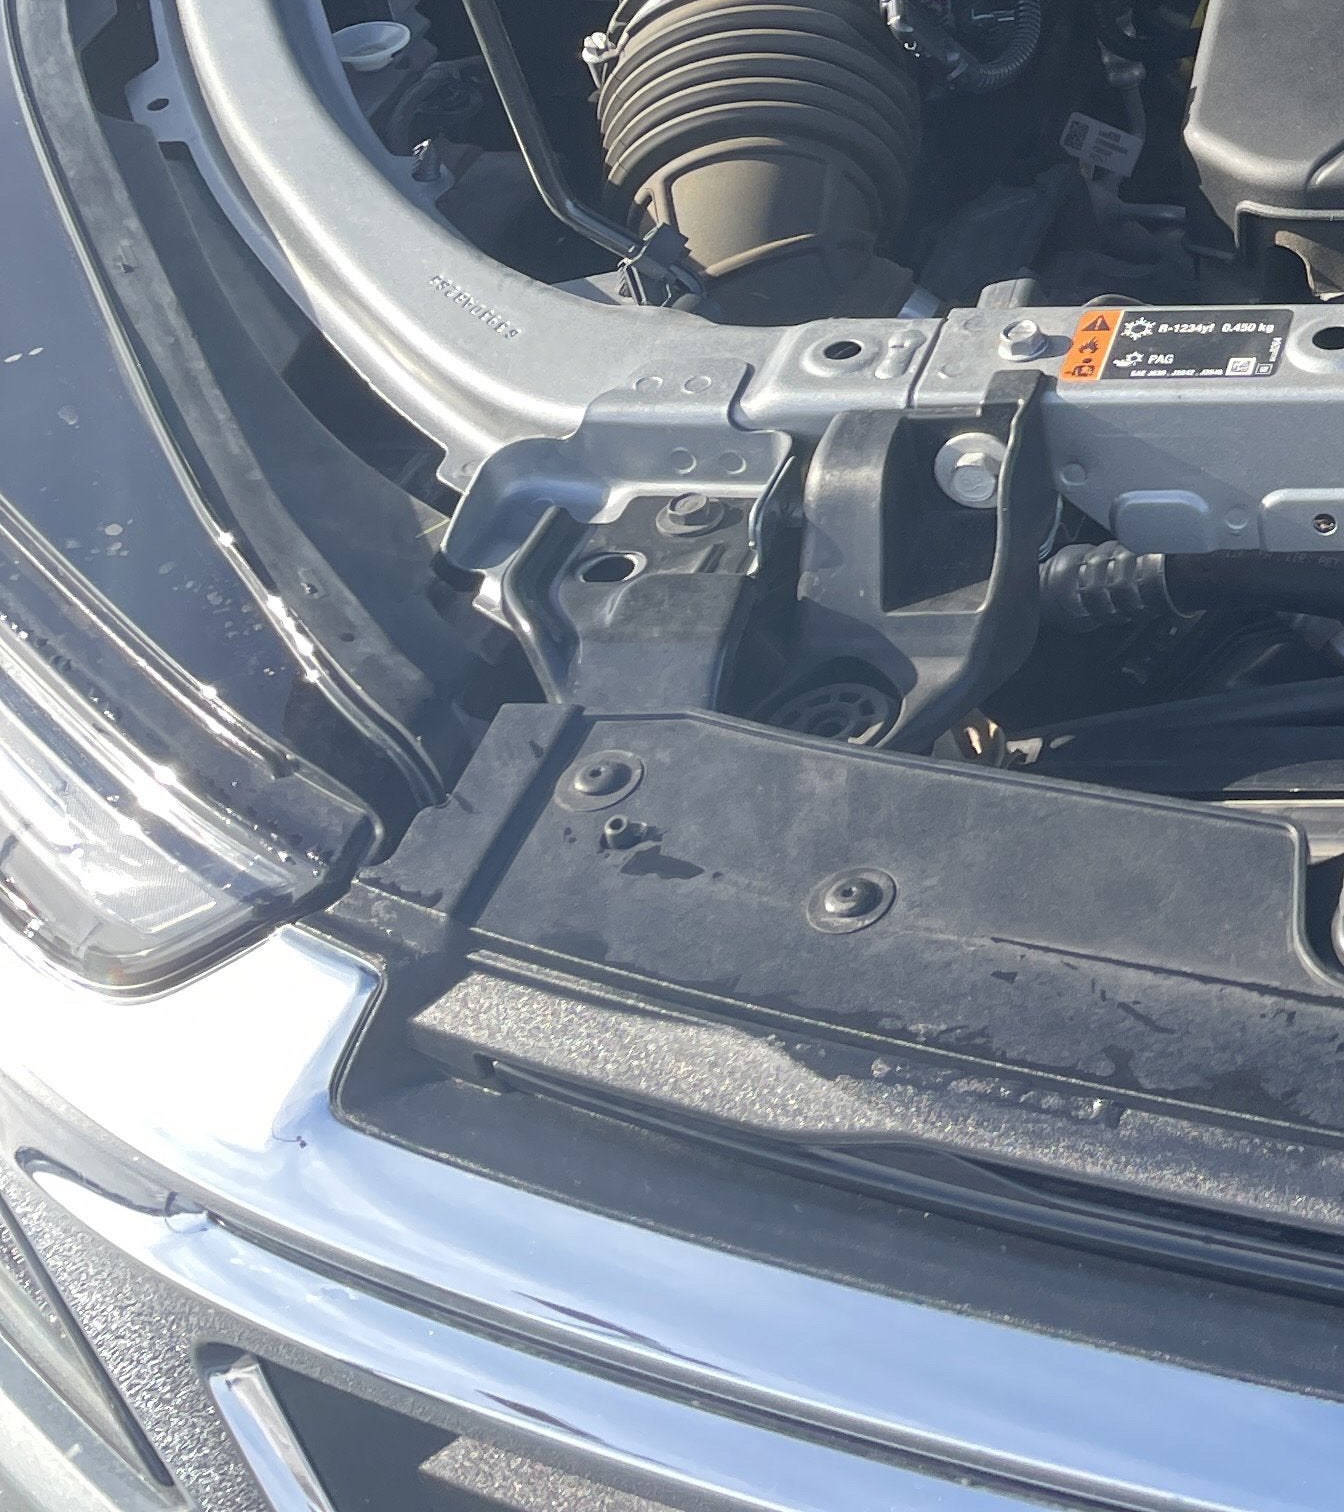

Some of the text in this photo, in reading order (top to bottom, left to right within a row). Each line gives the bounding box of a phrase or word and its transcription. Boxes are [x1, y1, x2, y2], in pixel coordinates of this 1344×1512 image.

[1158, 323, 1275, 335] R-1234yf 0.450 kg
[1147, 354, 1175, 364] PAG
